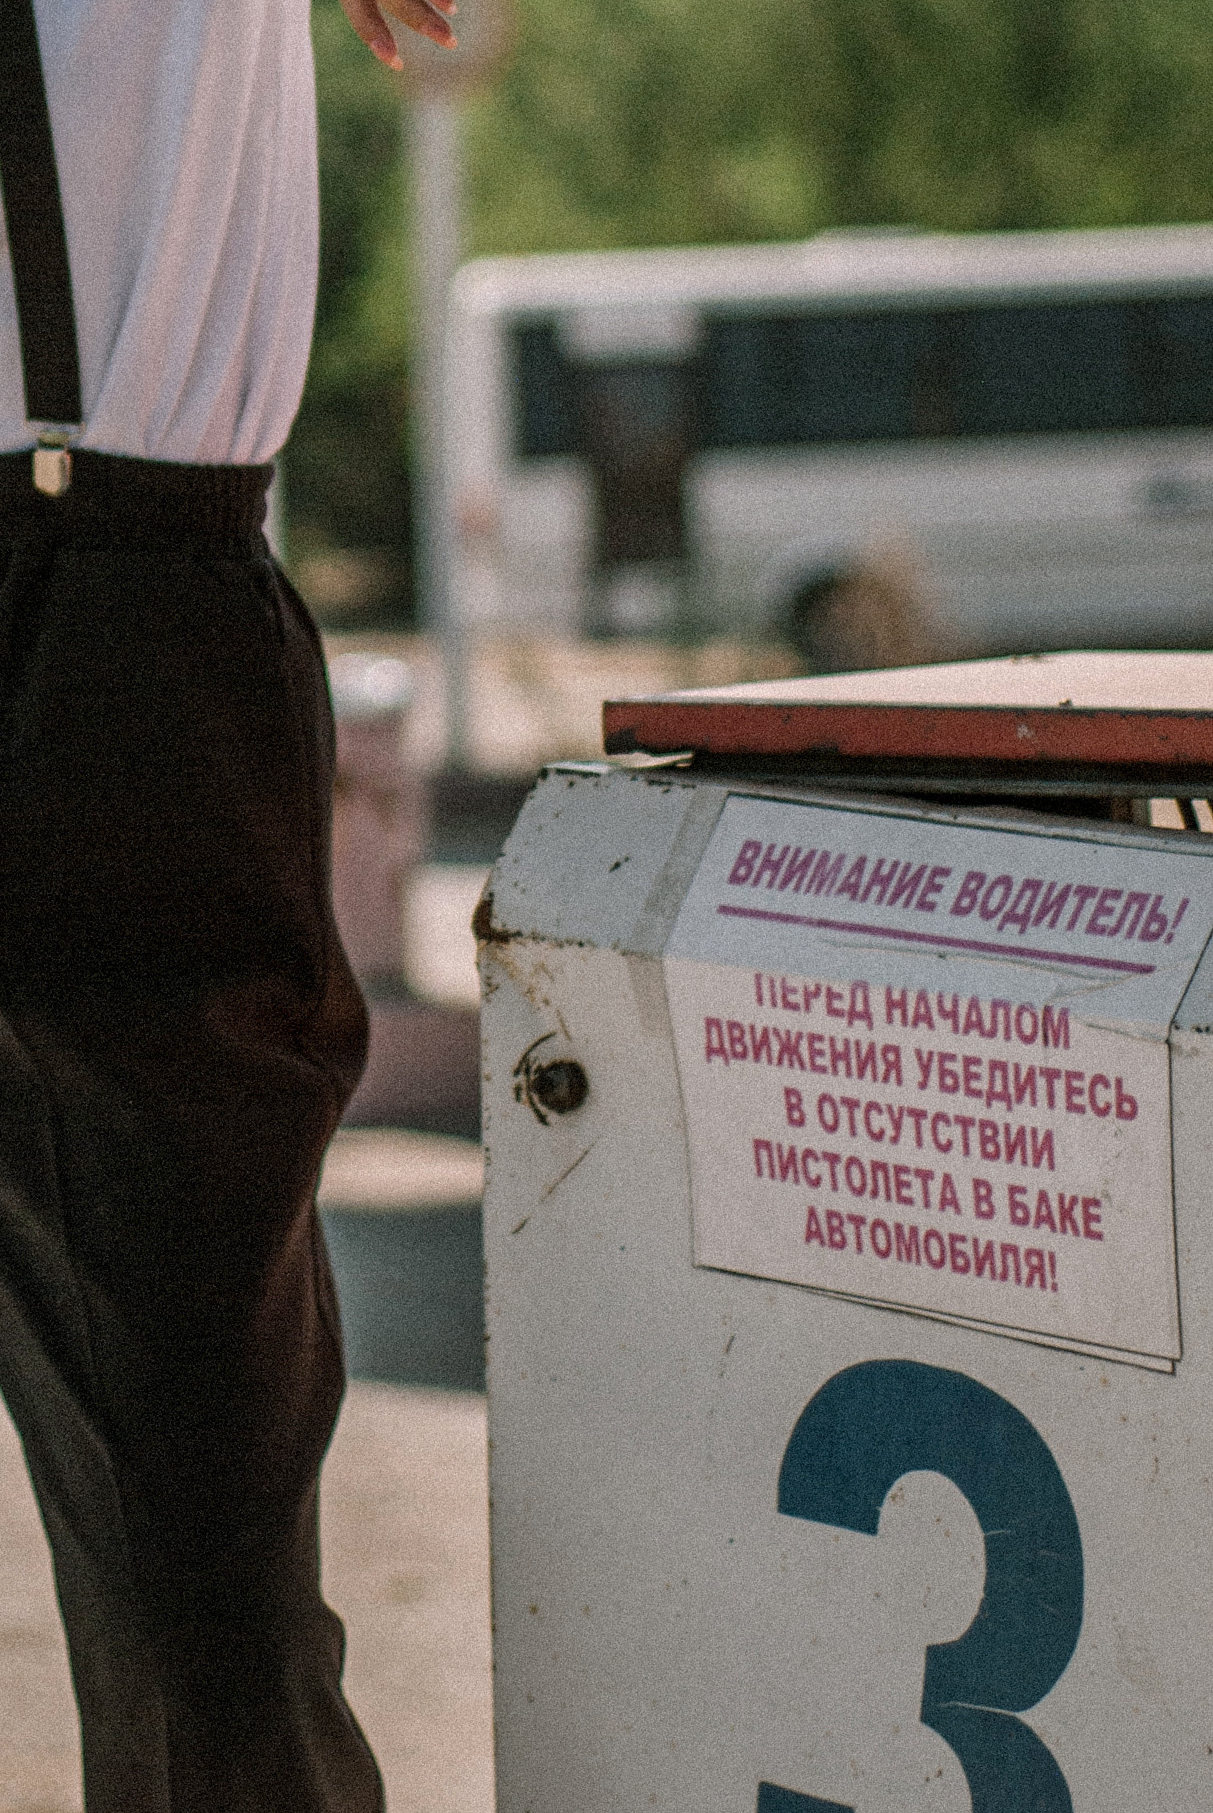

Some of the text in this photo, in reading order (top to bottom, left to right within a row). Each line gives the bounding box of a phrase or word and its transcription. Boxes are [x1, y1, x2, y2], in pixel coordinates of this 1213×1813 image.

[728, 840, 1189, 944] ВНИМАНИЕ ВОДИТЕЛЬ!
[754, 972, 1070, 1049] ПЕРЕД НАЧАЛОМ
[704, 1017, 1139, 1120] ДВИЖЕНИЯ УБЕДИТЕСЬ
[784, 1087, 1055, 1171] В ОТСУТСТВИИ
[753, 1138, 1104, 1241] ПИСТОЛЕТА В БАКЕ
[804, 1206, 1059, 1292] АВТОМОБИЛЯ!
[757, 1359, 1085, 1813] 3
